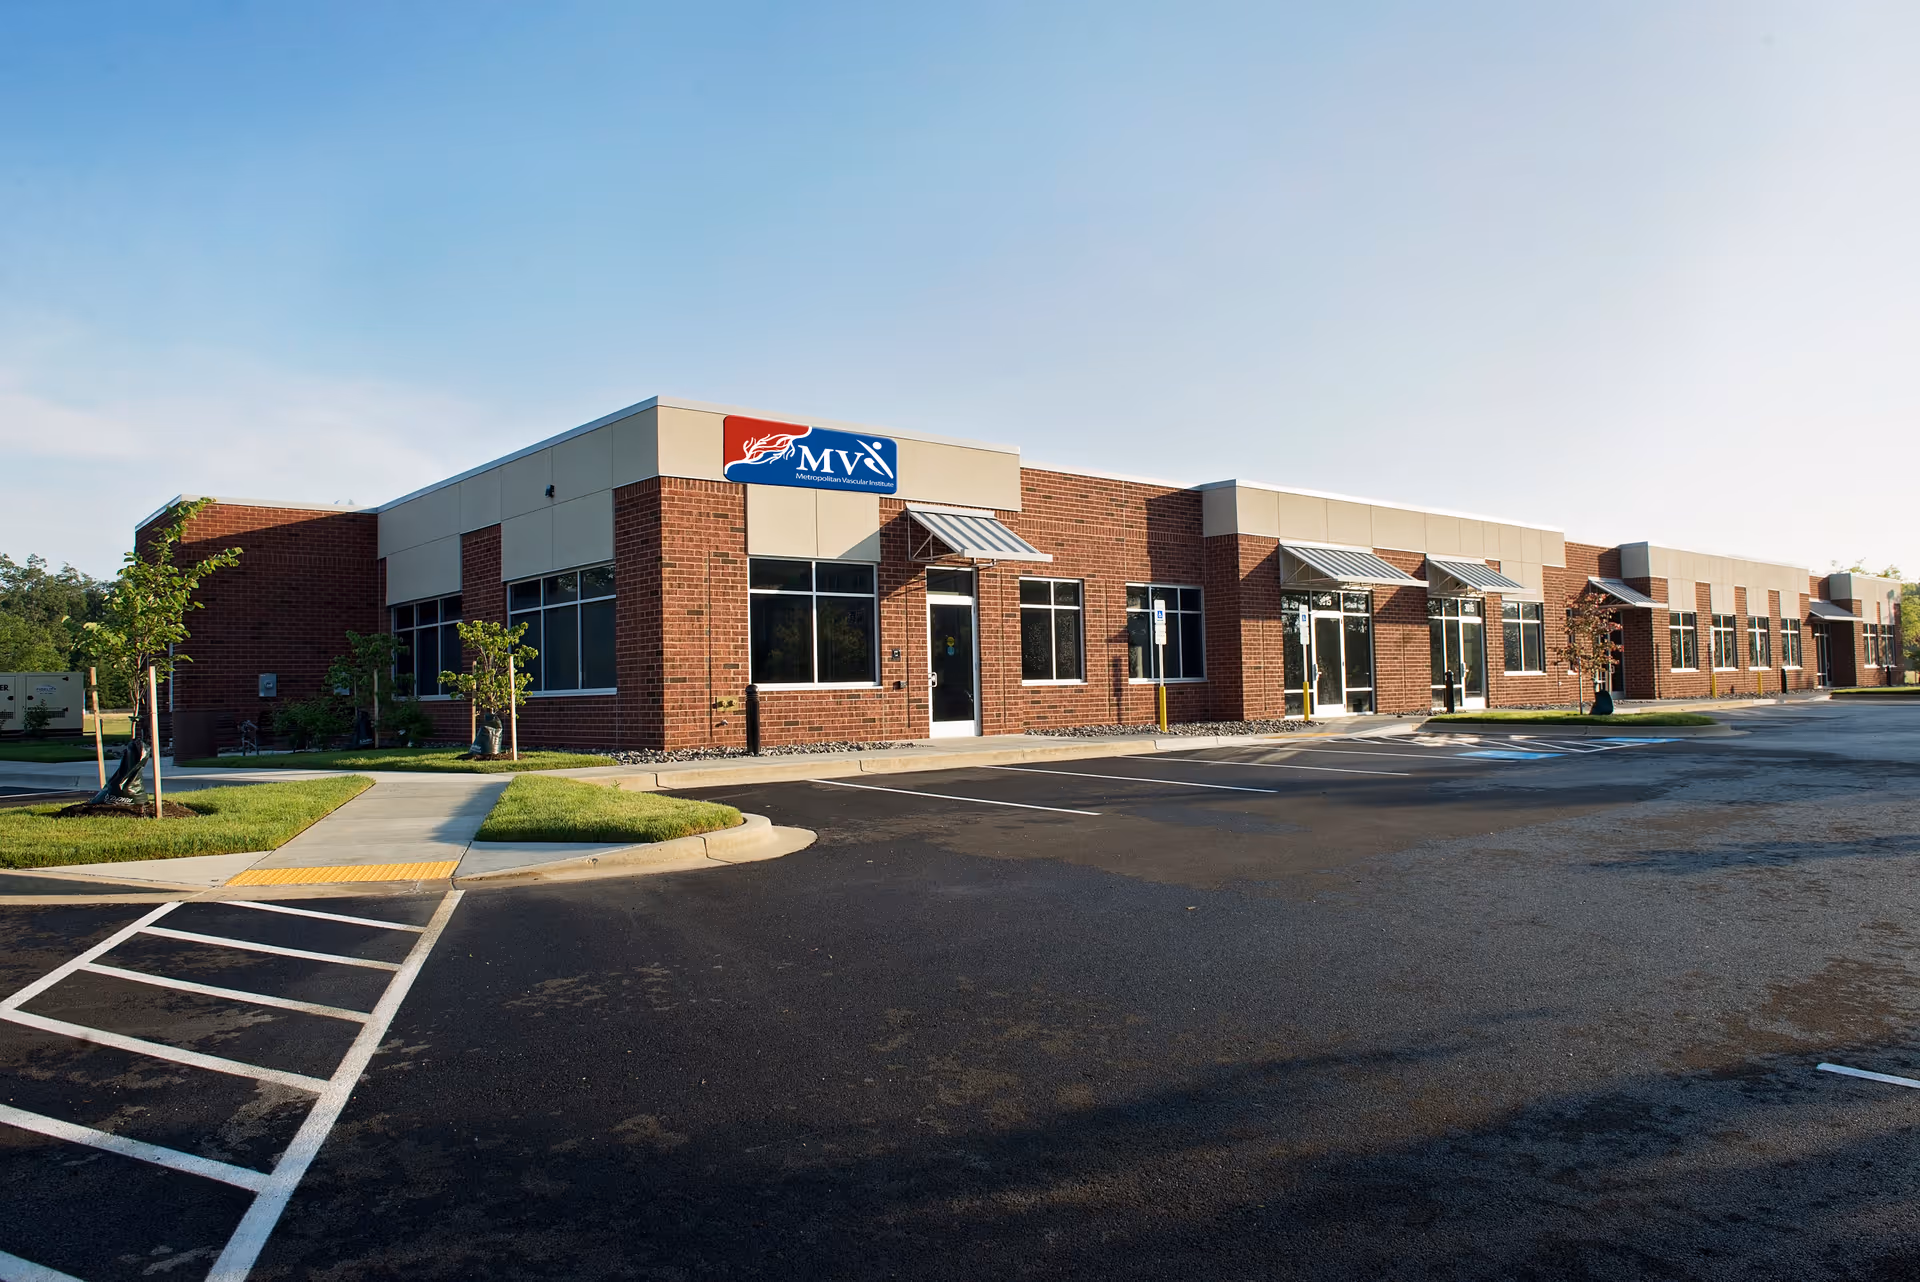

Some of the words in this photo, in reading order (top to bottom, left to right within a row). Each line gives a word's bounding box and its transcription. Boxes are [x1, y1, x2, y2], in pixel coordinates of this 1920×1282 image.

[795, 472, 842, 483] Metropolitan
[842, 477, 869, 485] Vascular
[869, 480, 894, 488] Institute
